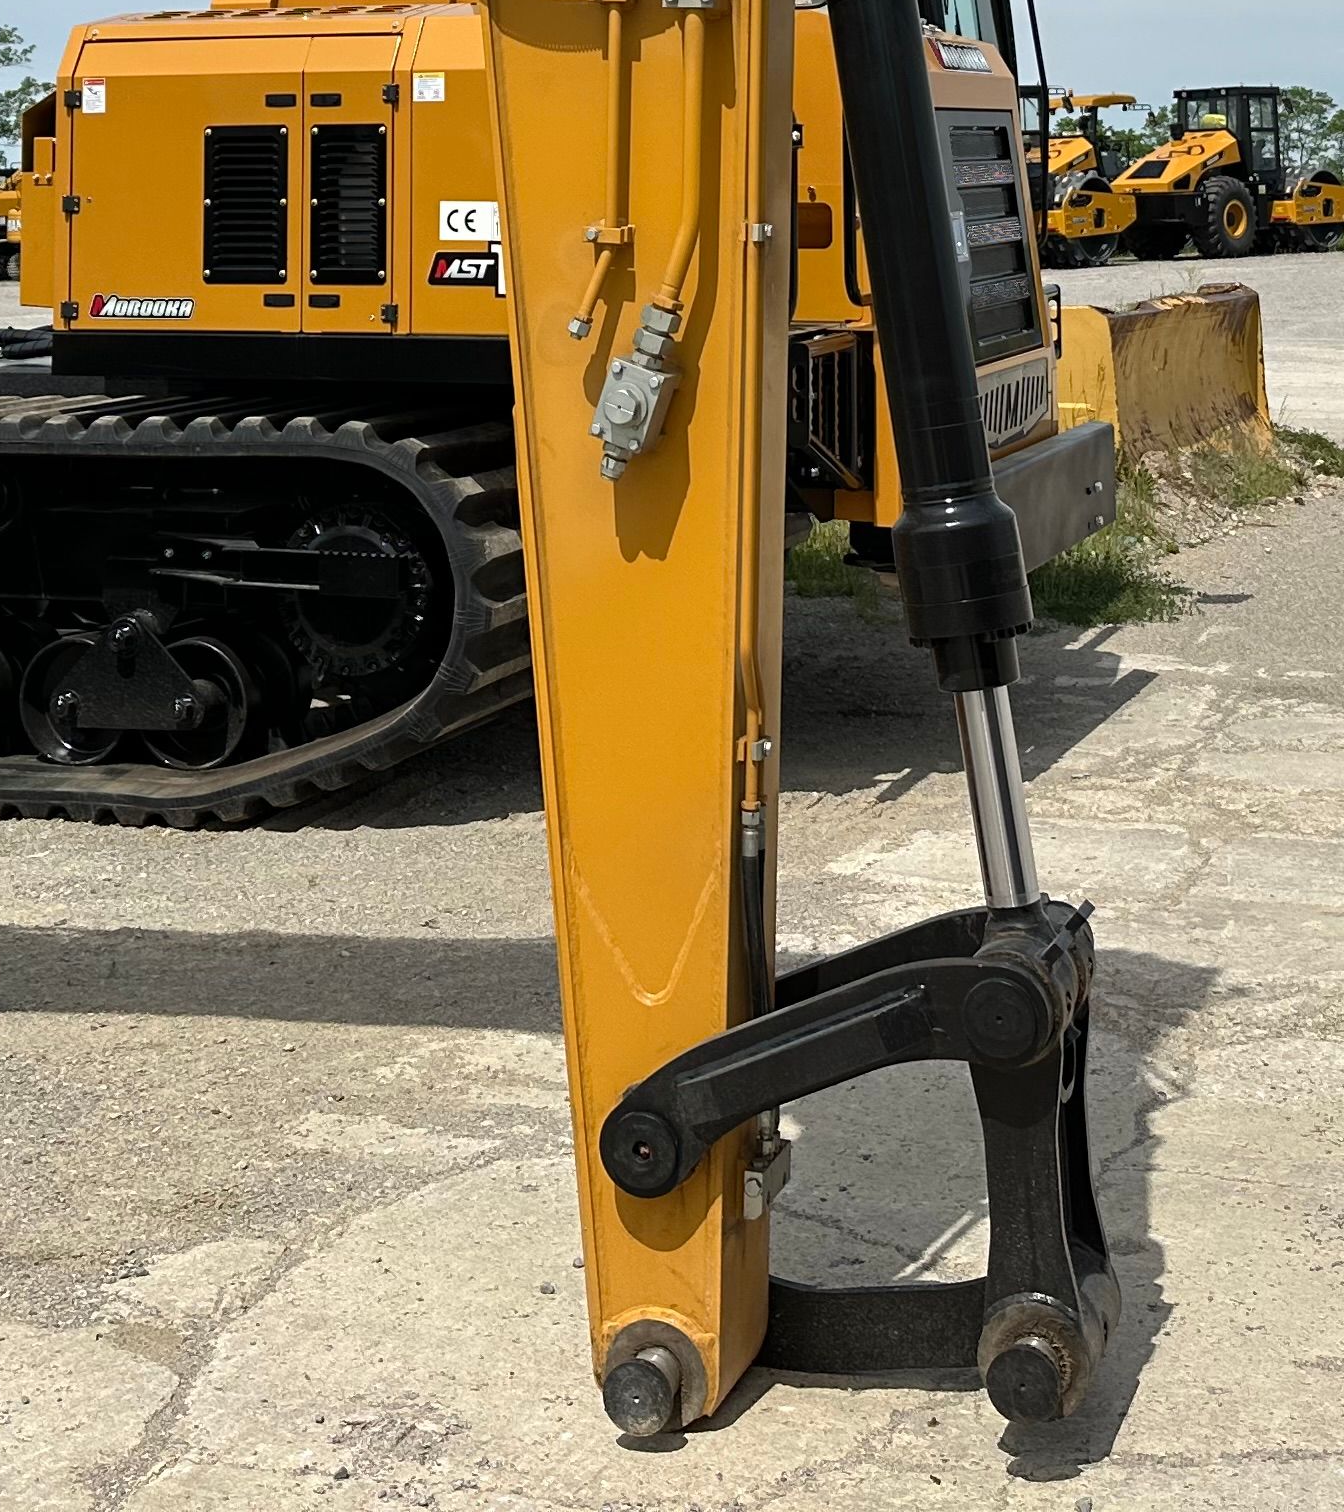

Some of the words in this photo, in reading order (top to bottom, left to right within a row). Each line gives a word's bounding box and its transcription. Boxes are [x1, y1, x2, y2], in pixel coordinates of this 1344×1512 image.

[446, 209, 476, 232] CE
[434, 259, 495, 279] MST
[91, 295, 194, 317] MOROOKA
